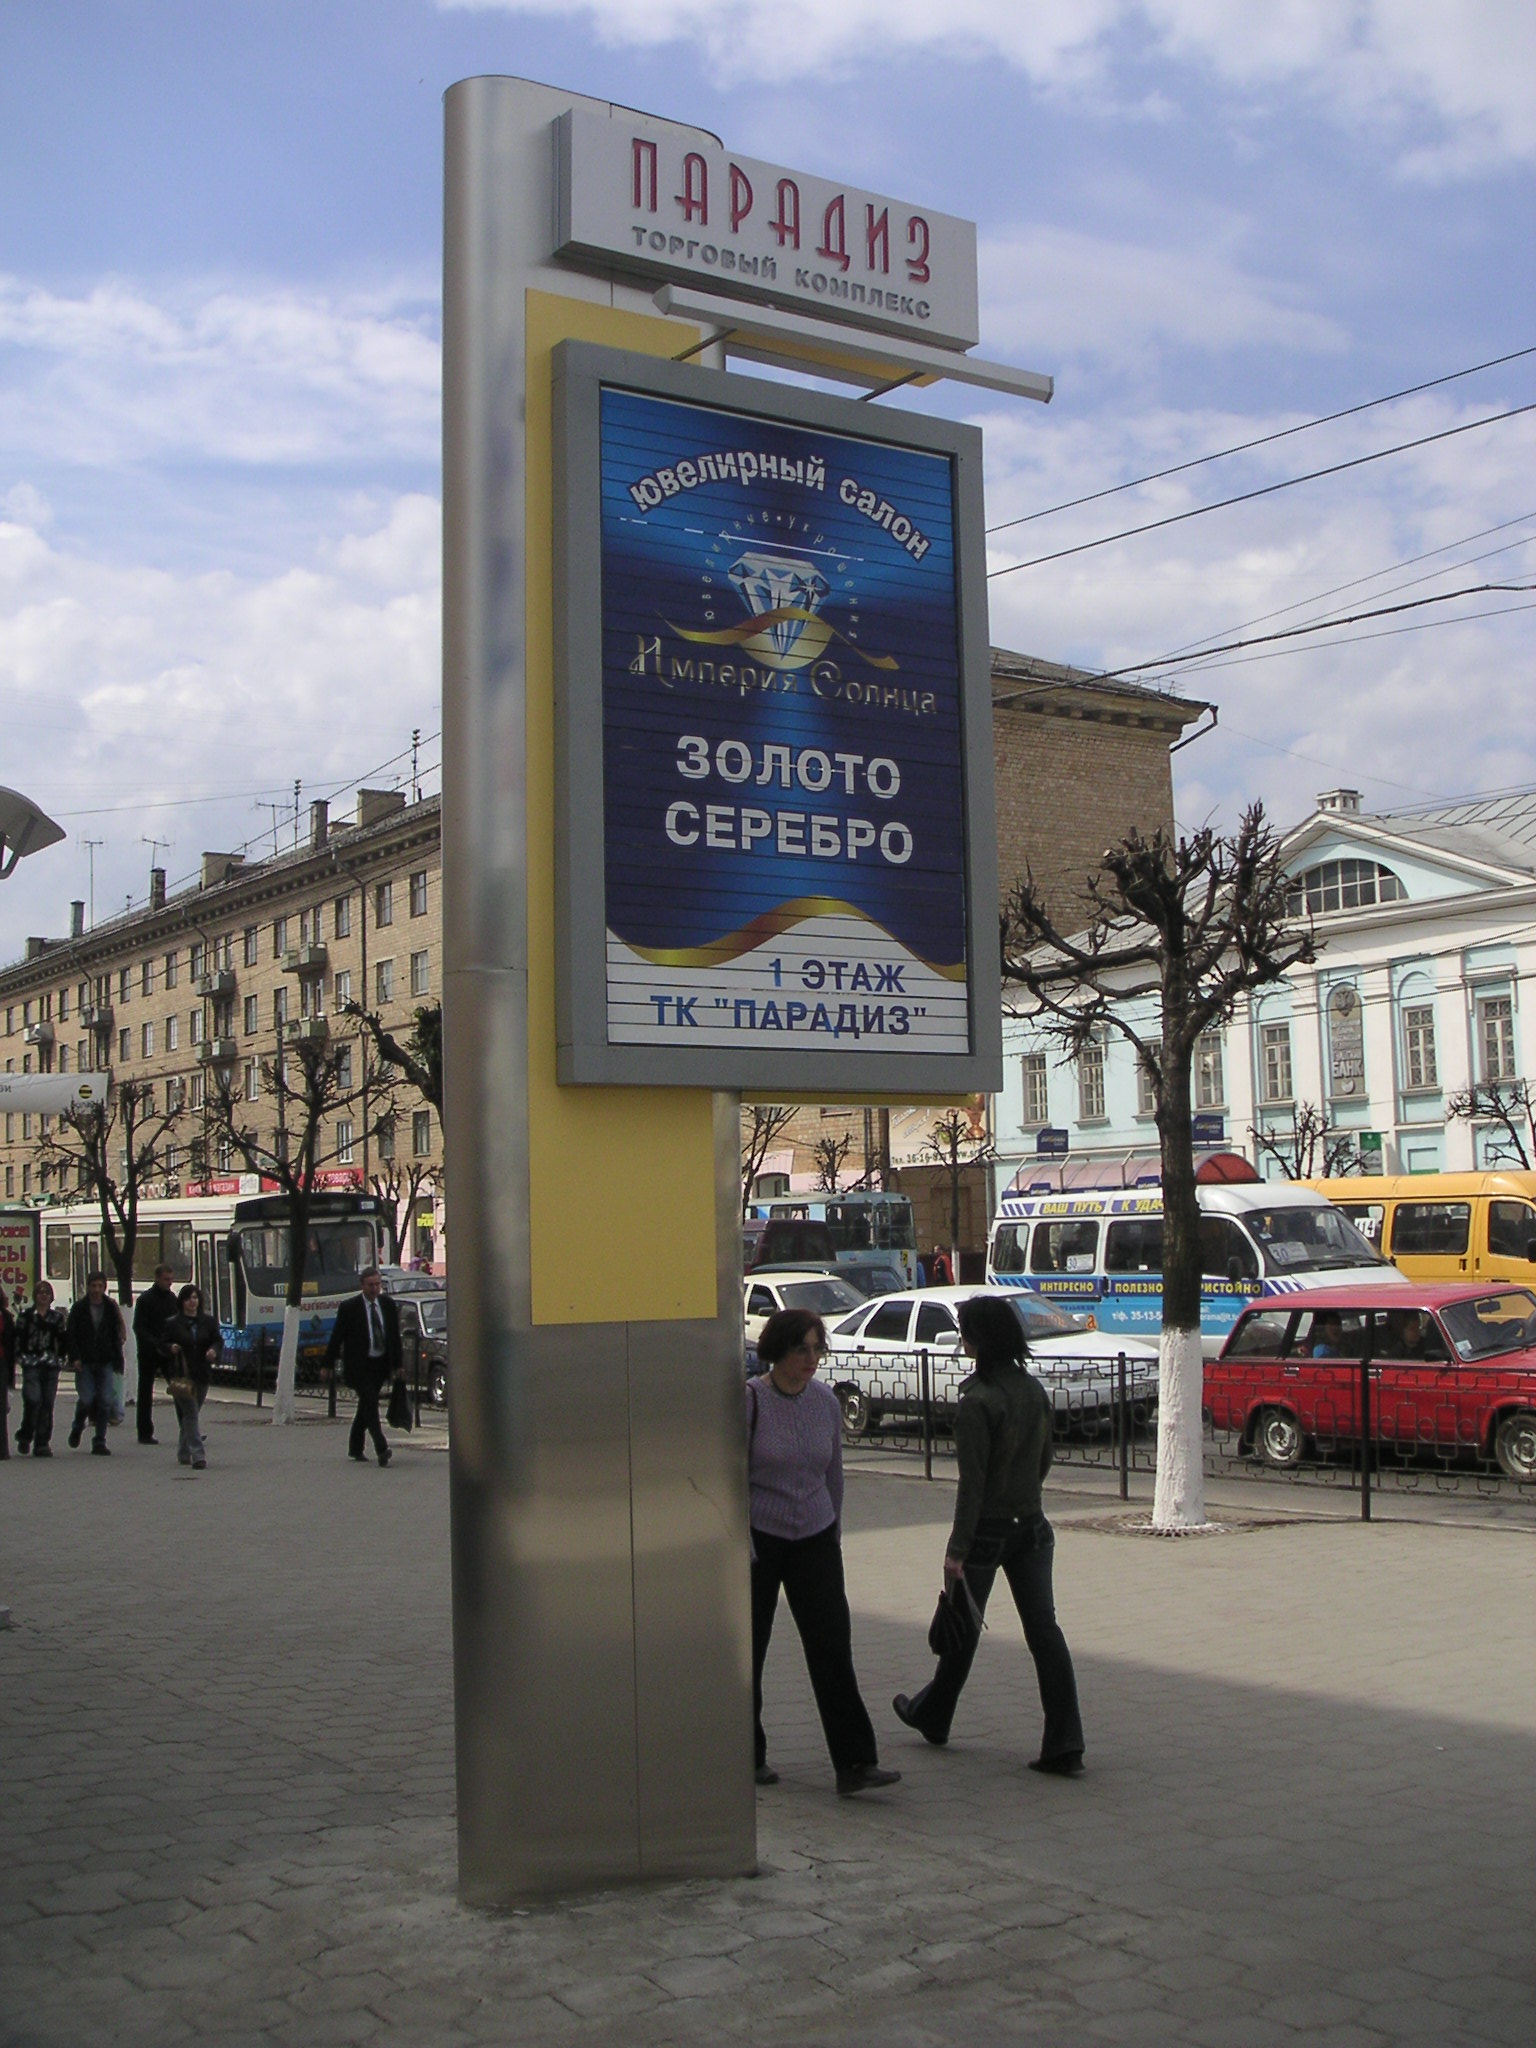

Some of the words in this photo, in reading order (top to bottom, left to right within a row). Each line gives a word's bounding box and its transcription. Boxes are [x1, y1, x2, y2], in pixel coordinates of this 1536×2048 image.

[632, 137, 930, 283] ПАРАДИЗ
[632, 225, 777, 281] ТОРГОВЫЙ
[795, 269, 931, 320] КОМПЛЕКС
[629, 450, 826, 511] Ювелирный
[839, 478, 930, 559] салон
[629, 634, 798, 696] Империя
[810, 660, 937, 716] Солнца
[676, 735, 901, 799] ЗОЛОТО
[665, 801, 914, 864] СЕРЕБРО
[768, 958, 782, 988] 1
[801, 959, 906, 993] ЭТАЖ
[649, 994, 699, 1027] ТК
[715, 997, 927, 1039] "ПАРАДИЗ"
[1333, 1060, 1364, 1078] БАНК
[1042, 1202, 1067, 1214] ВАШ
[1072, 1201, 1102, 1213] ПУТЬ
[1121, 1200, 1130, 1212] К
[0, 1267, 28, 1284] СЬ
[1040, 1281, 1094, 1292] ИНТЕРЕСНО
[1115, 1282, 1164, 1293] ПОЛЕЗНО
[1201, 1281, 1261, 1294] ИСТОЙНО
